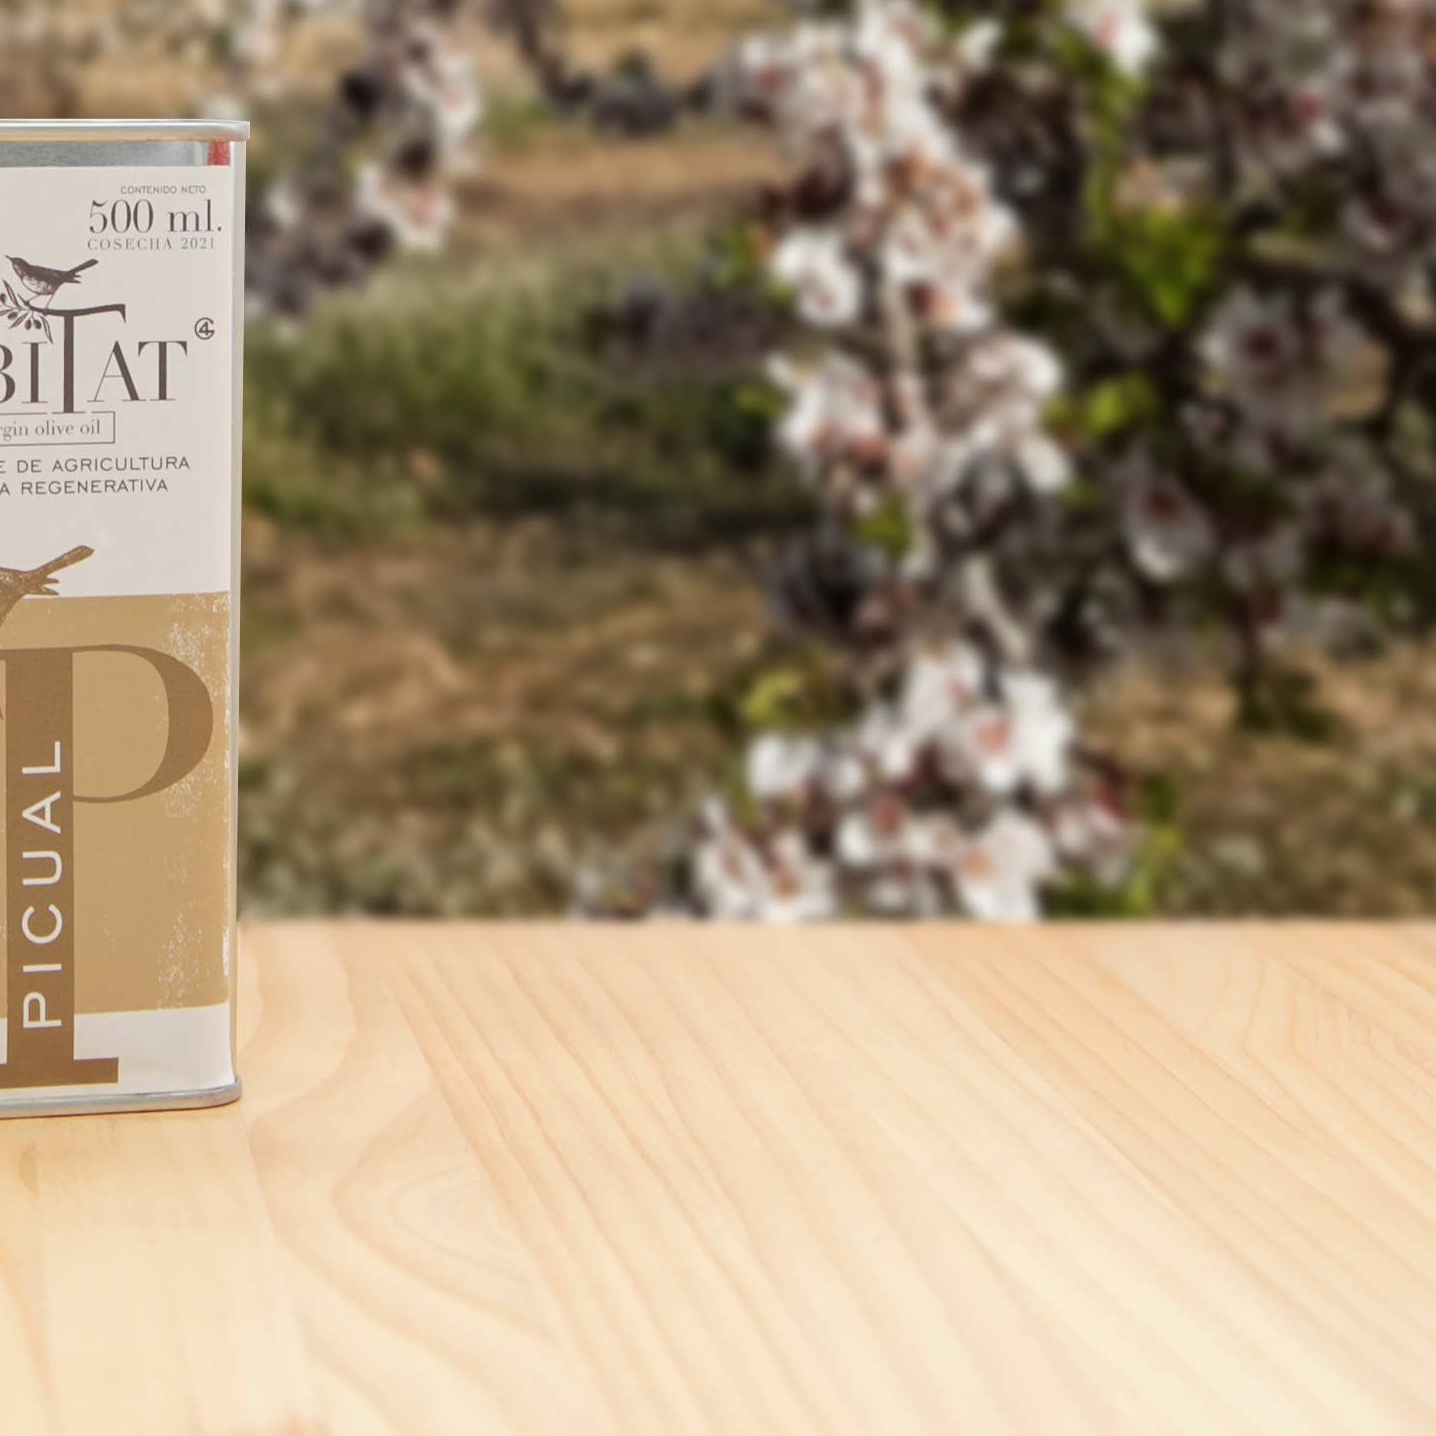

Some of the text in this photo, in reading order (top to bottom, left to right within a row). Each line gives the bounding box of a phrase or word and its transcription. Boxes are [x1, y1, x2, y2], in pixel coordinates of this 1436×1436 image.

[120, 185, 206, 195] CONTENIDO NETO
[89, 198, 222, 234] 500 ml.
[87, 237, 216, 251] COSECHA 2021
[35, 418, 75, 437] olive
[80, 418, 101, 435] oil
[17, 459, 42, 474] DE
[52, 456, 191, 473] AGRICULTURA
[21, 479, 169, 496] REGENERATIVA
[22, 741, 64, 1029] PICUAL
